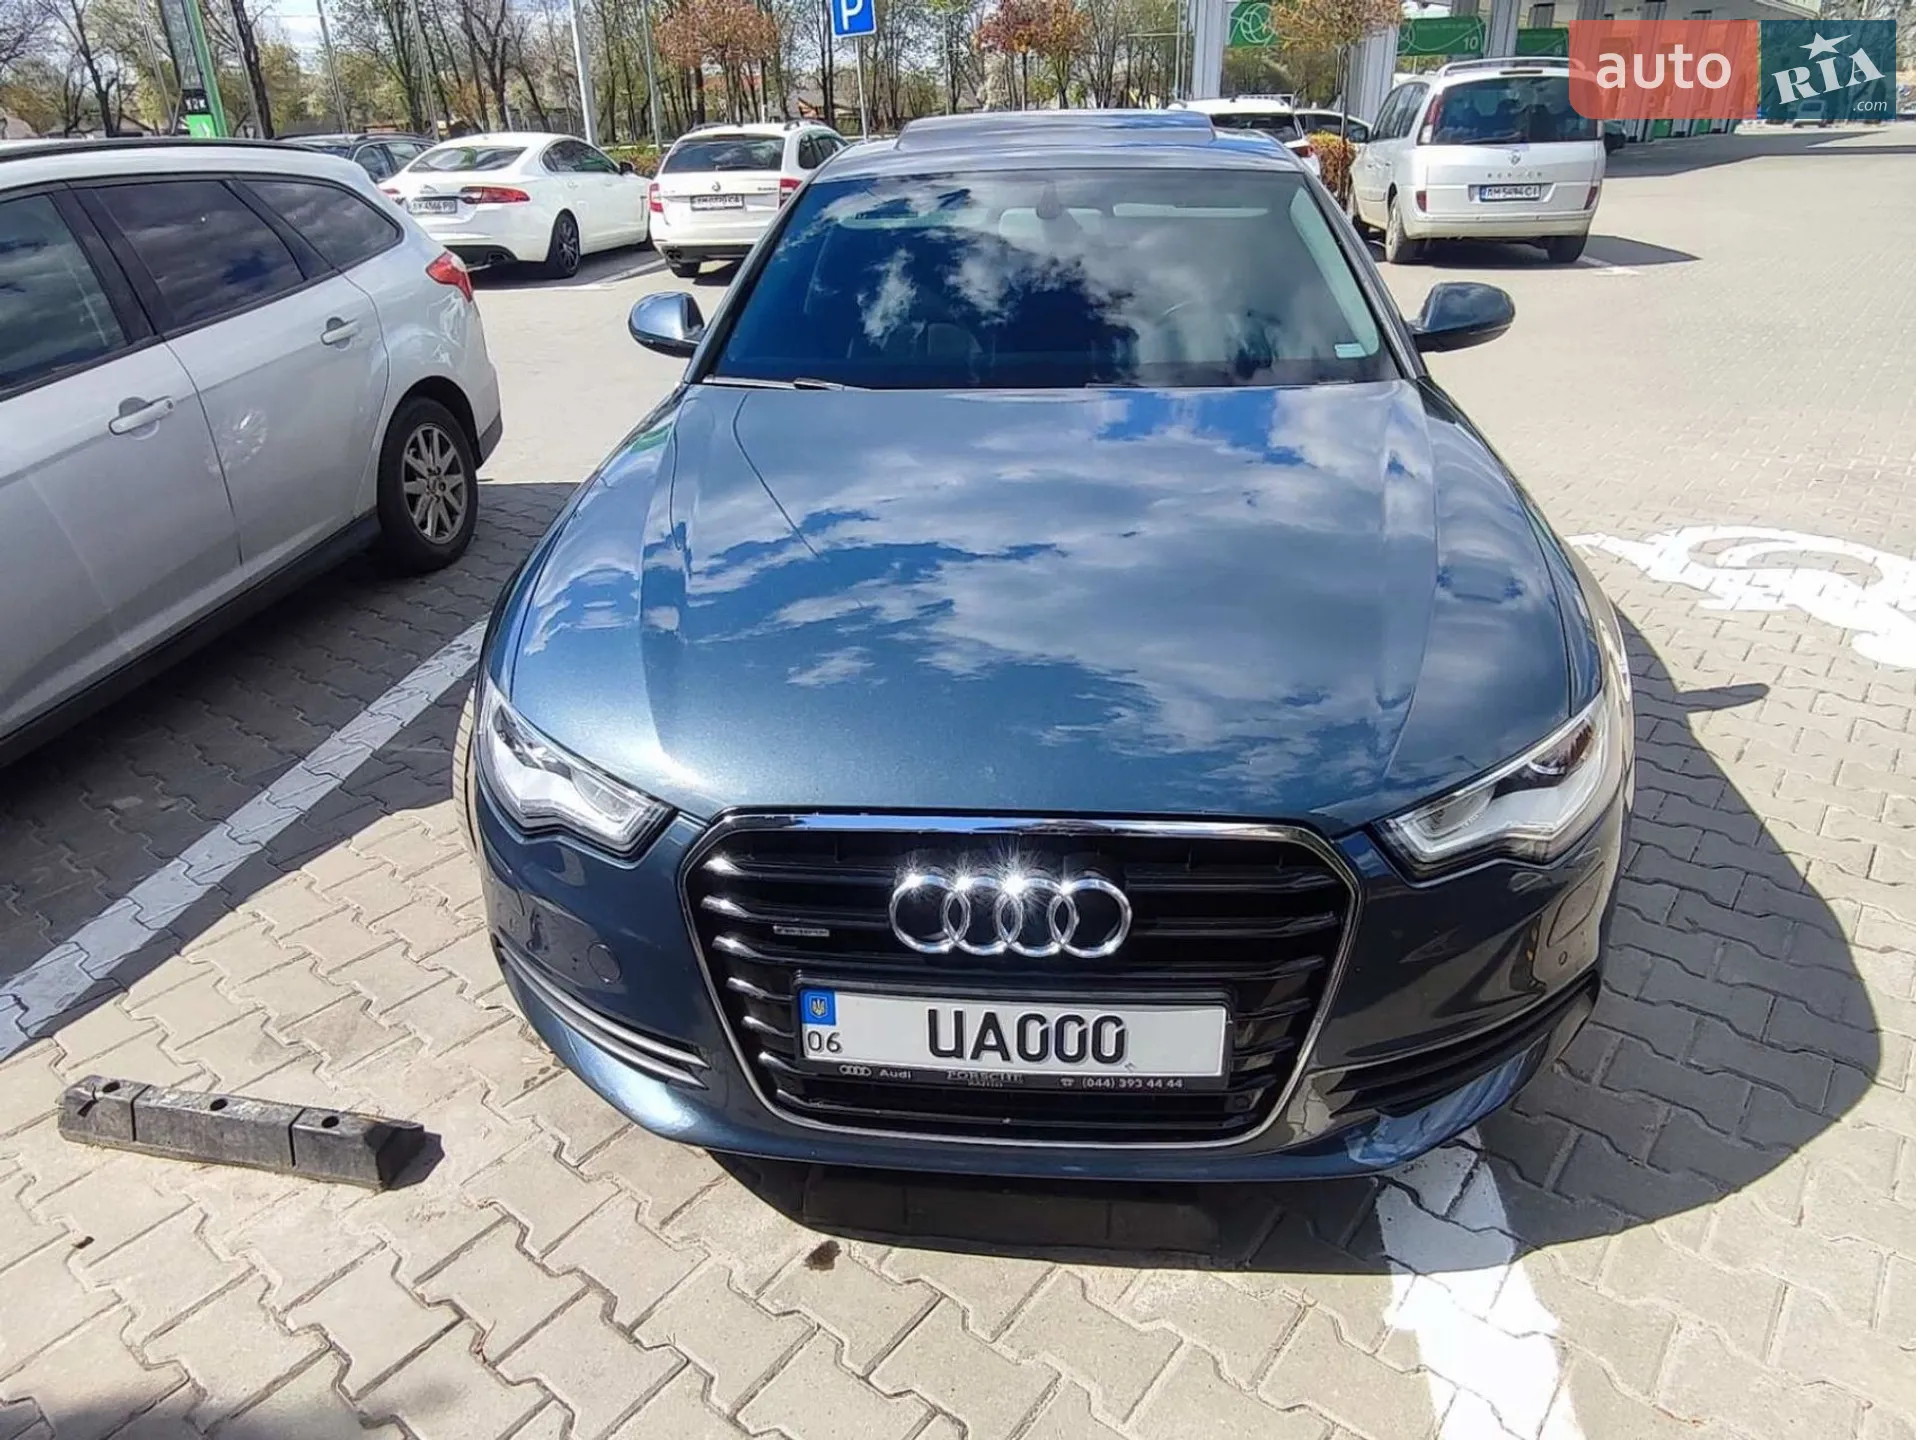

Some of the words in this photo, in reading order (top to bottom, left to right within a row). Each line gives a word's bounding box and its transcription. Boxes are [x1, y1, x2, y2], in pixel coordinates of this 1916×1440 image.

[841, 0, 863, 30] P
[1463, 36, 1479, 50] 10
[807, 1030, 842, 1054] 06
[928, 1008, 1126, 1065] UA000
[880, 1069, 911, 1079] Audi
[1082, 1077, 1115, 1089] (044)
[1119, 1077, 1142, 1089] 393
[1147, 1078, 1163, 1089] 44
[1166, 1079, 1183, 1089] 44
